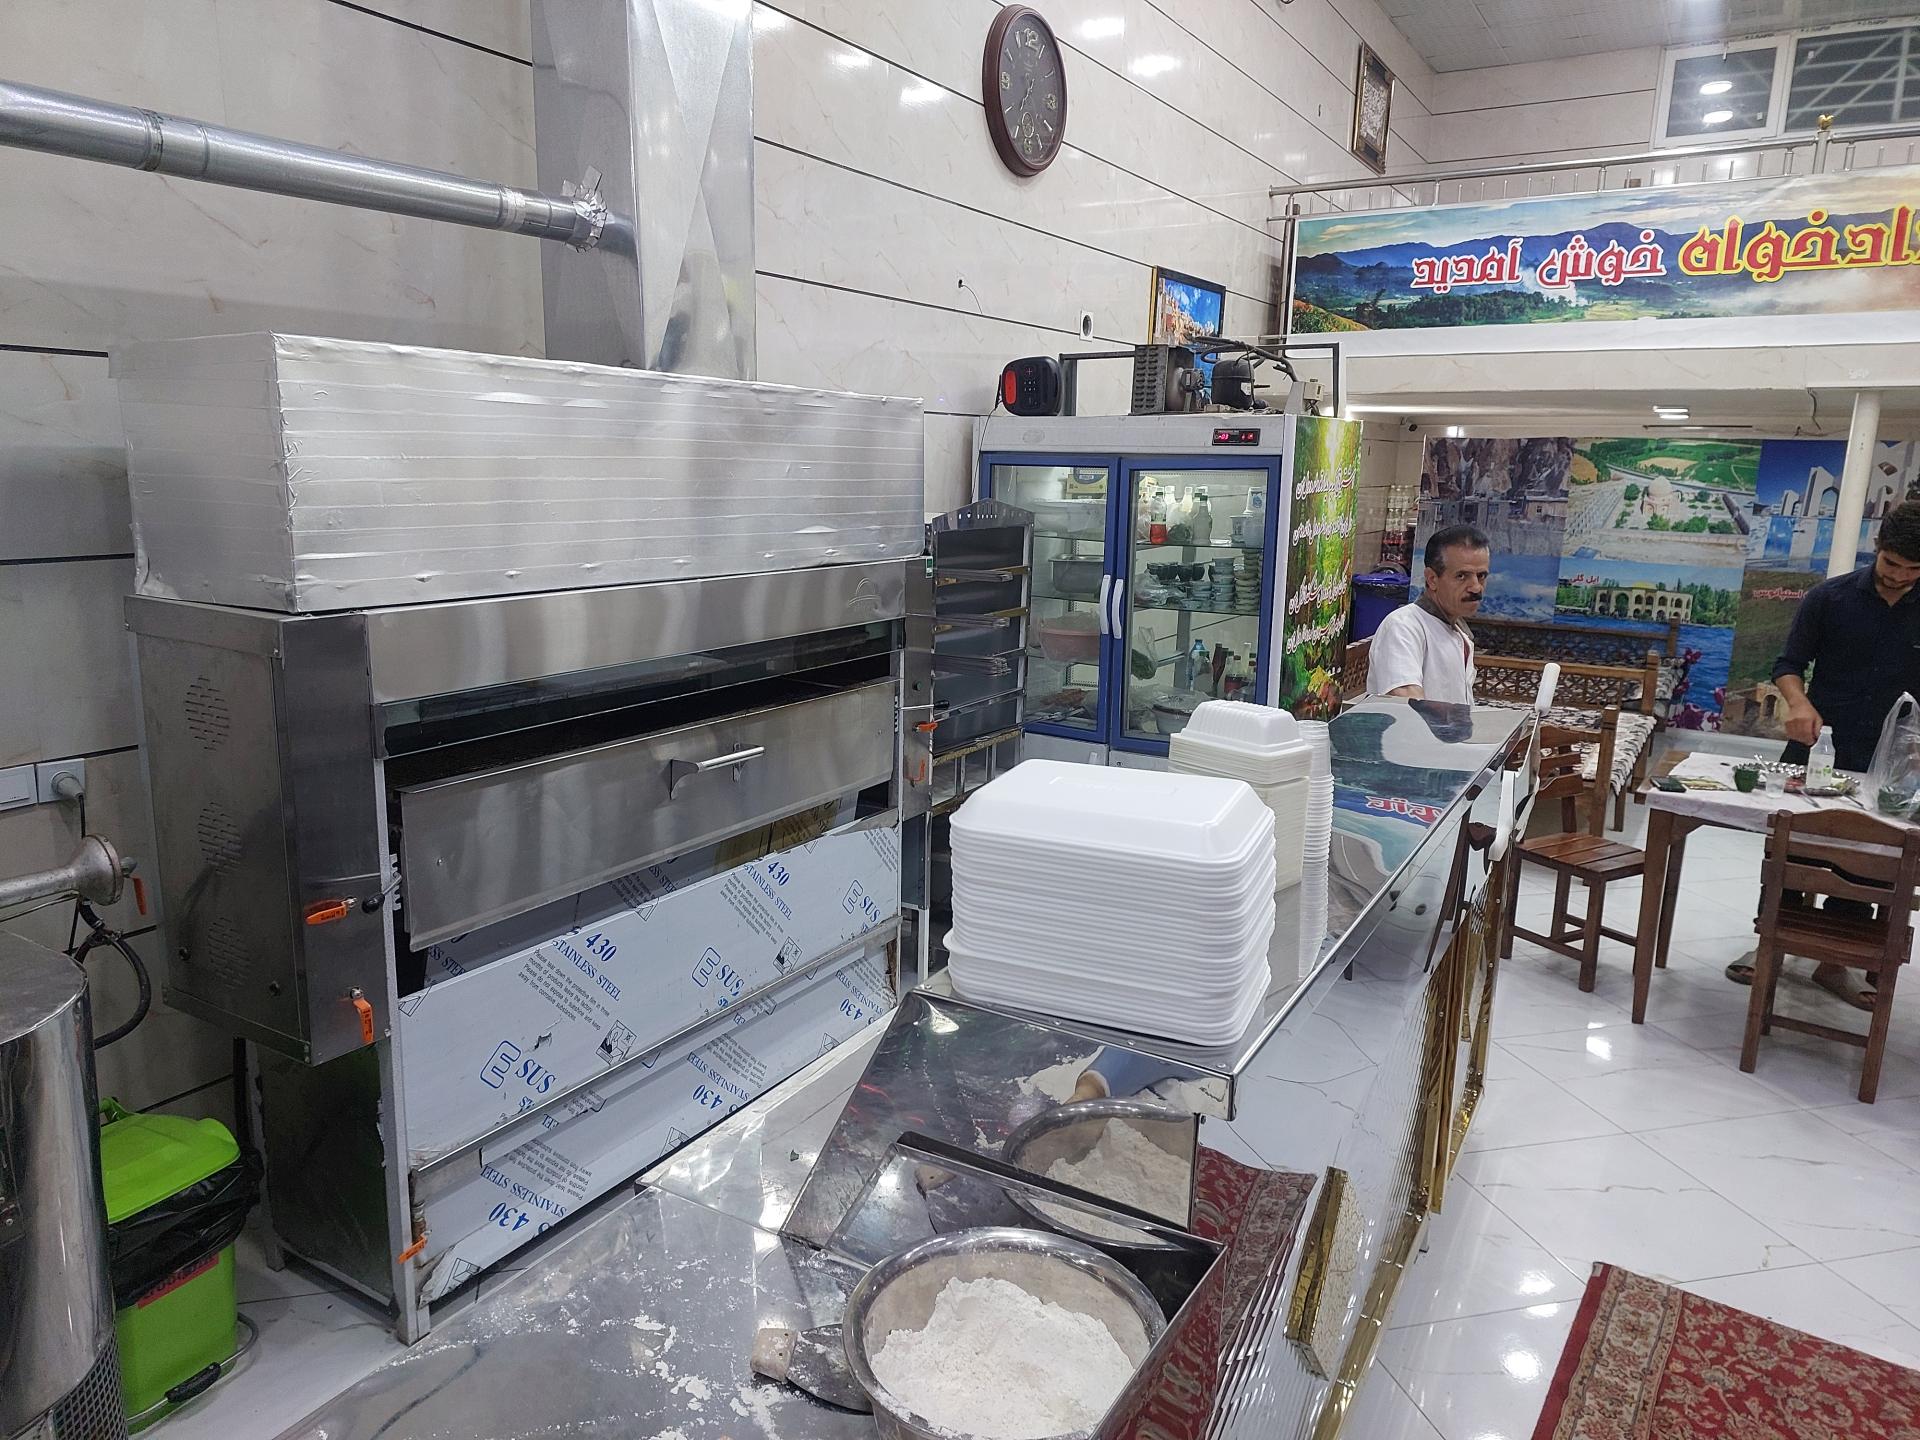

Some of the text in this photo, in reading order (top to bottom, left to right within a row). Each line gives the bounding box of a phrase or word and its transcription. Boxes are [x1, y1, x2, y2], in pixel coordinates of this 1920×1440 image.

[1410, 236, 1523, 294] آمدید
[1537, 229, 1667, 288] خوش
[768, 861, 790, 886] 430
[744, 864, 792, 920] STAINLESS STEEL
[860, 896, 880, 922] SUS
[585, 933, 617, 961] 430
[552, 940, 621, 1001] STAINLESS STEEL
[716, 965, 744, 996] SUS
[840, 999, 863, 1020] 430
[515, 1059, 556, 1093] SUS
[708, 1069, 750, 1101] STAINLESS
[693, 1084, 723, 1109] 430
[510, 1183, 567, 1217] STAINLESS
[489, 1202, 530, 1231] 430
